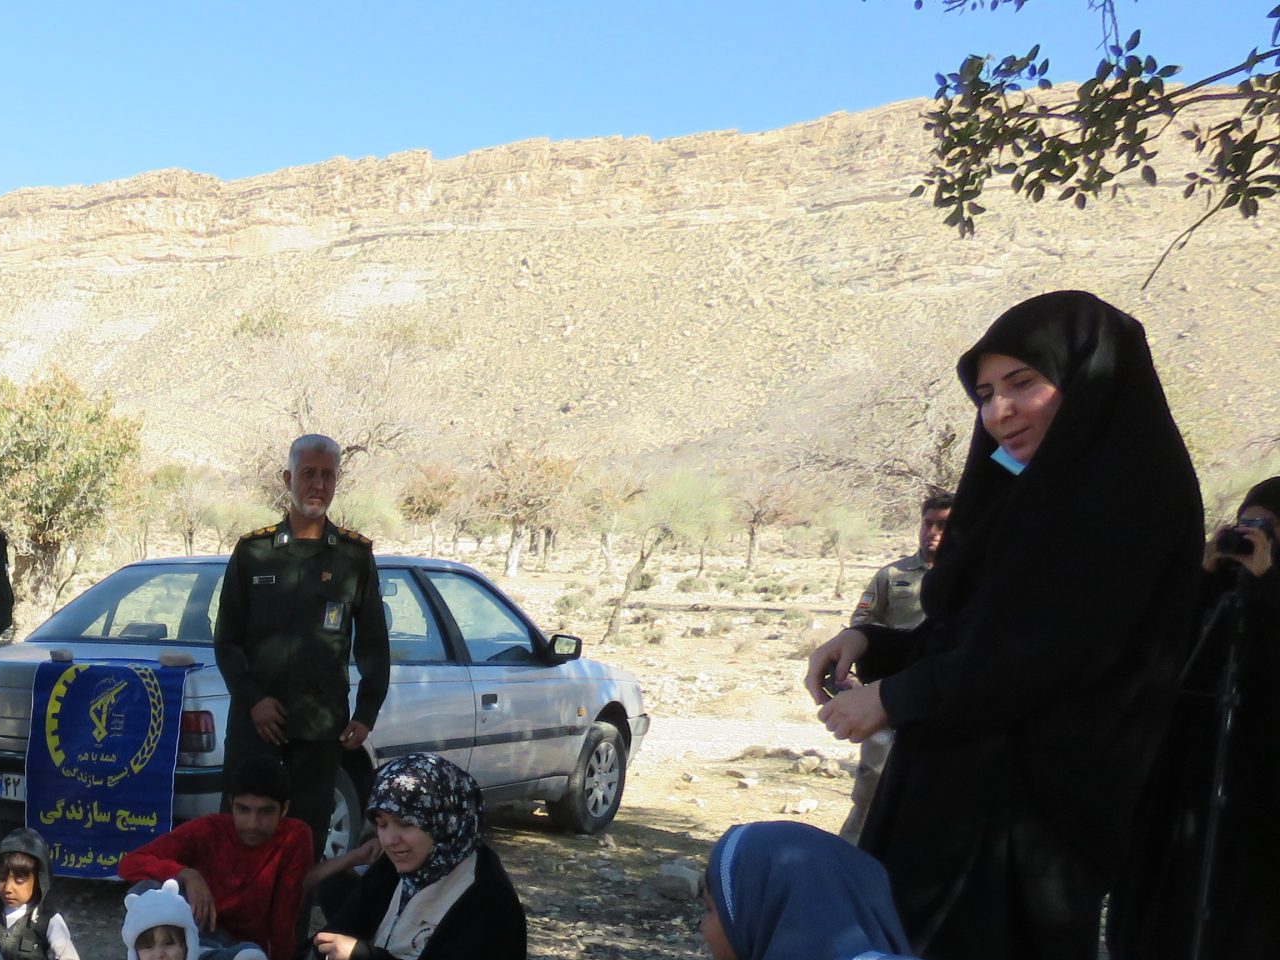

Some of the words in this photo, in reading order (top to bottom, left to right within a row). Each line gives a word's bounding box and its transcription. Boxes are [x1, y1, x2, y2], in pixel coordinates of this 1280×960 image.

[61, 766, 104, 788] سازندگی
[107, 766, 130, 788] بسیج
[39, 798, 111, 829] سازندگی
[115, 808, 158, 833] بسیج
[96, 850, 128, 870] احیه
